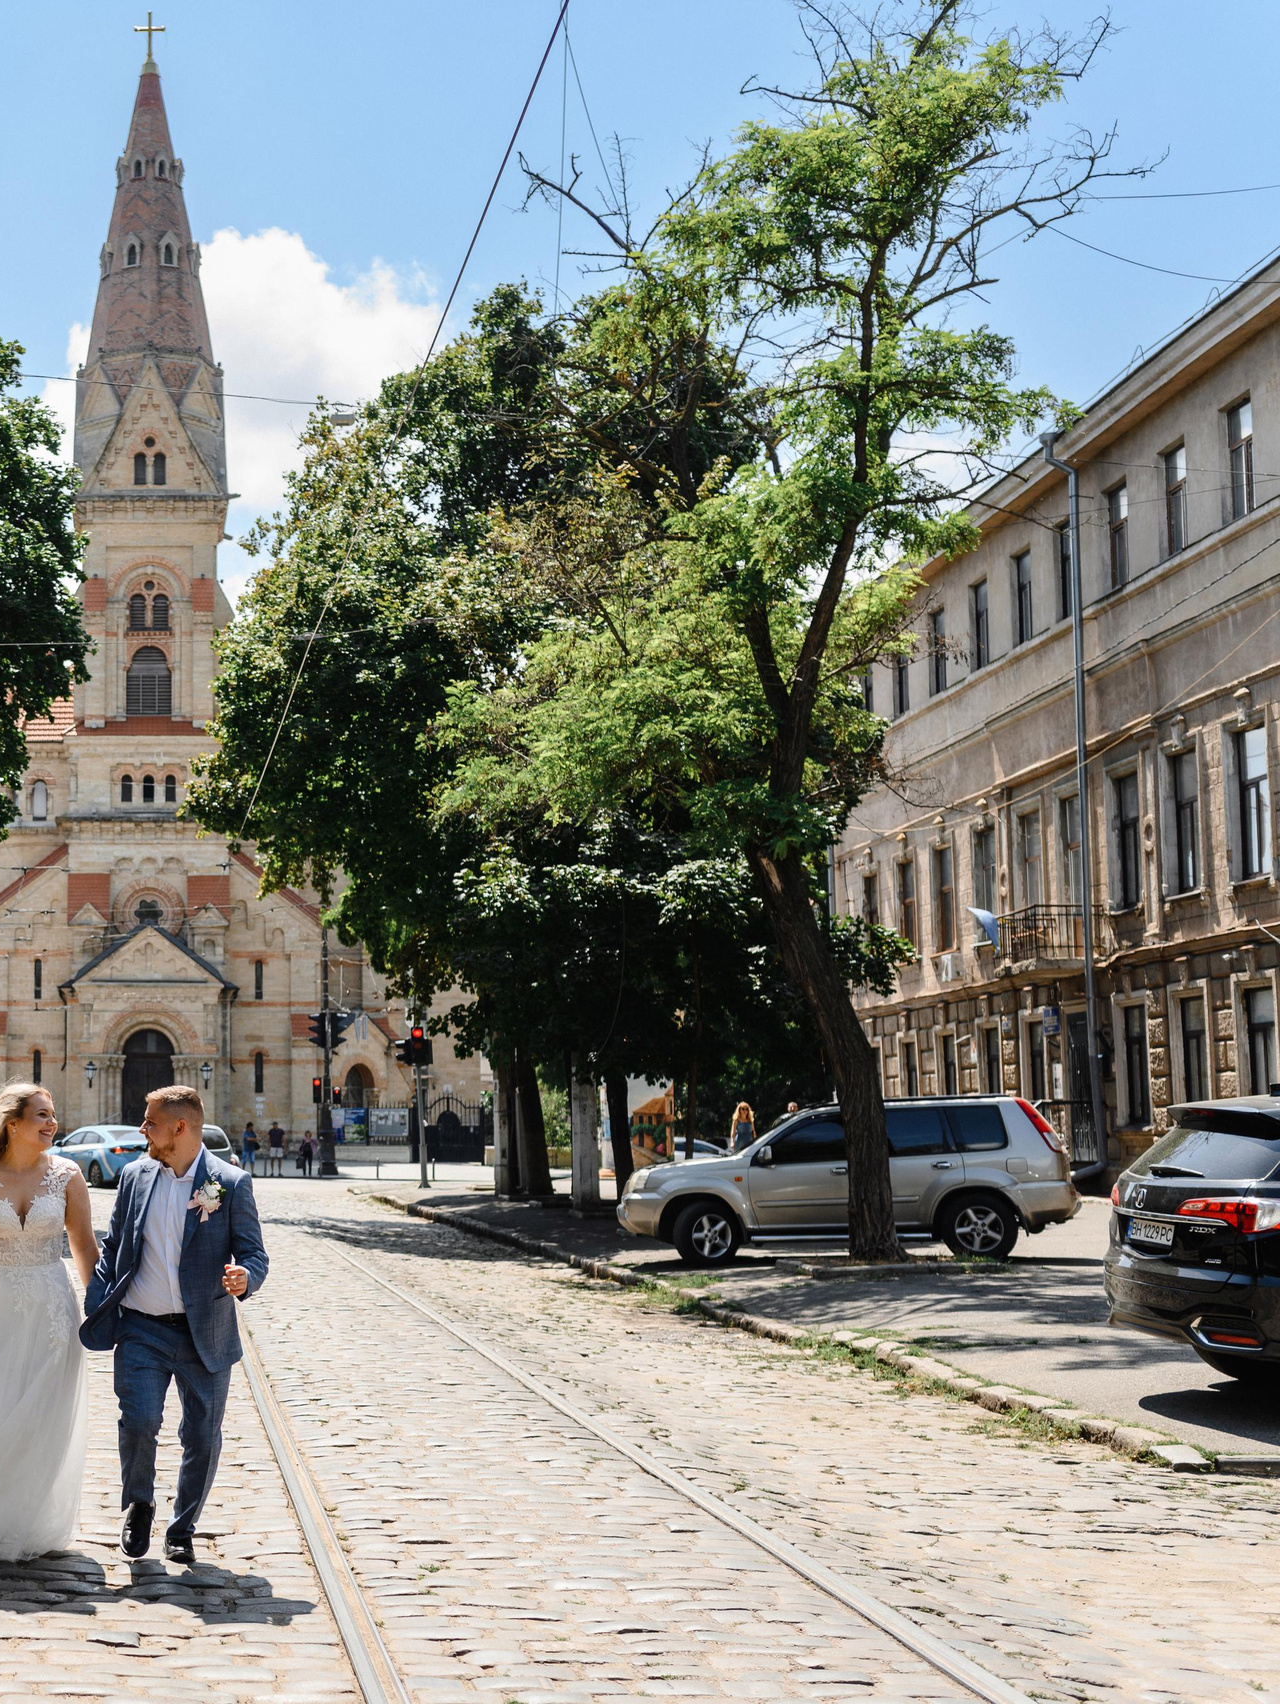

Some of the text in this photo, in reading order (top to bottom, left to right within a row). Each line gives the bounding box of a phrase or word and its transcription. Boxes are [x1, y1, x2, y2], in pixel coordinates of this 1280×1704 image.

[1131, 1222, 1173, 1242] BH 1229 PC
[1189, 1226, 1217, 1234] RDX
